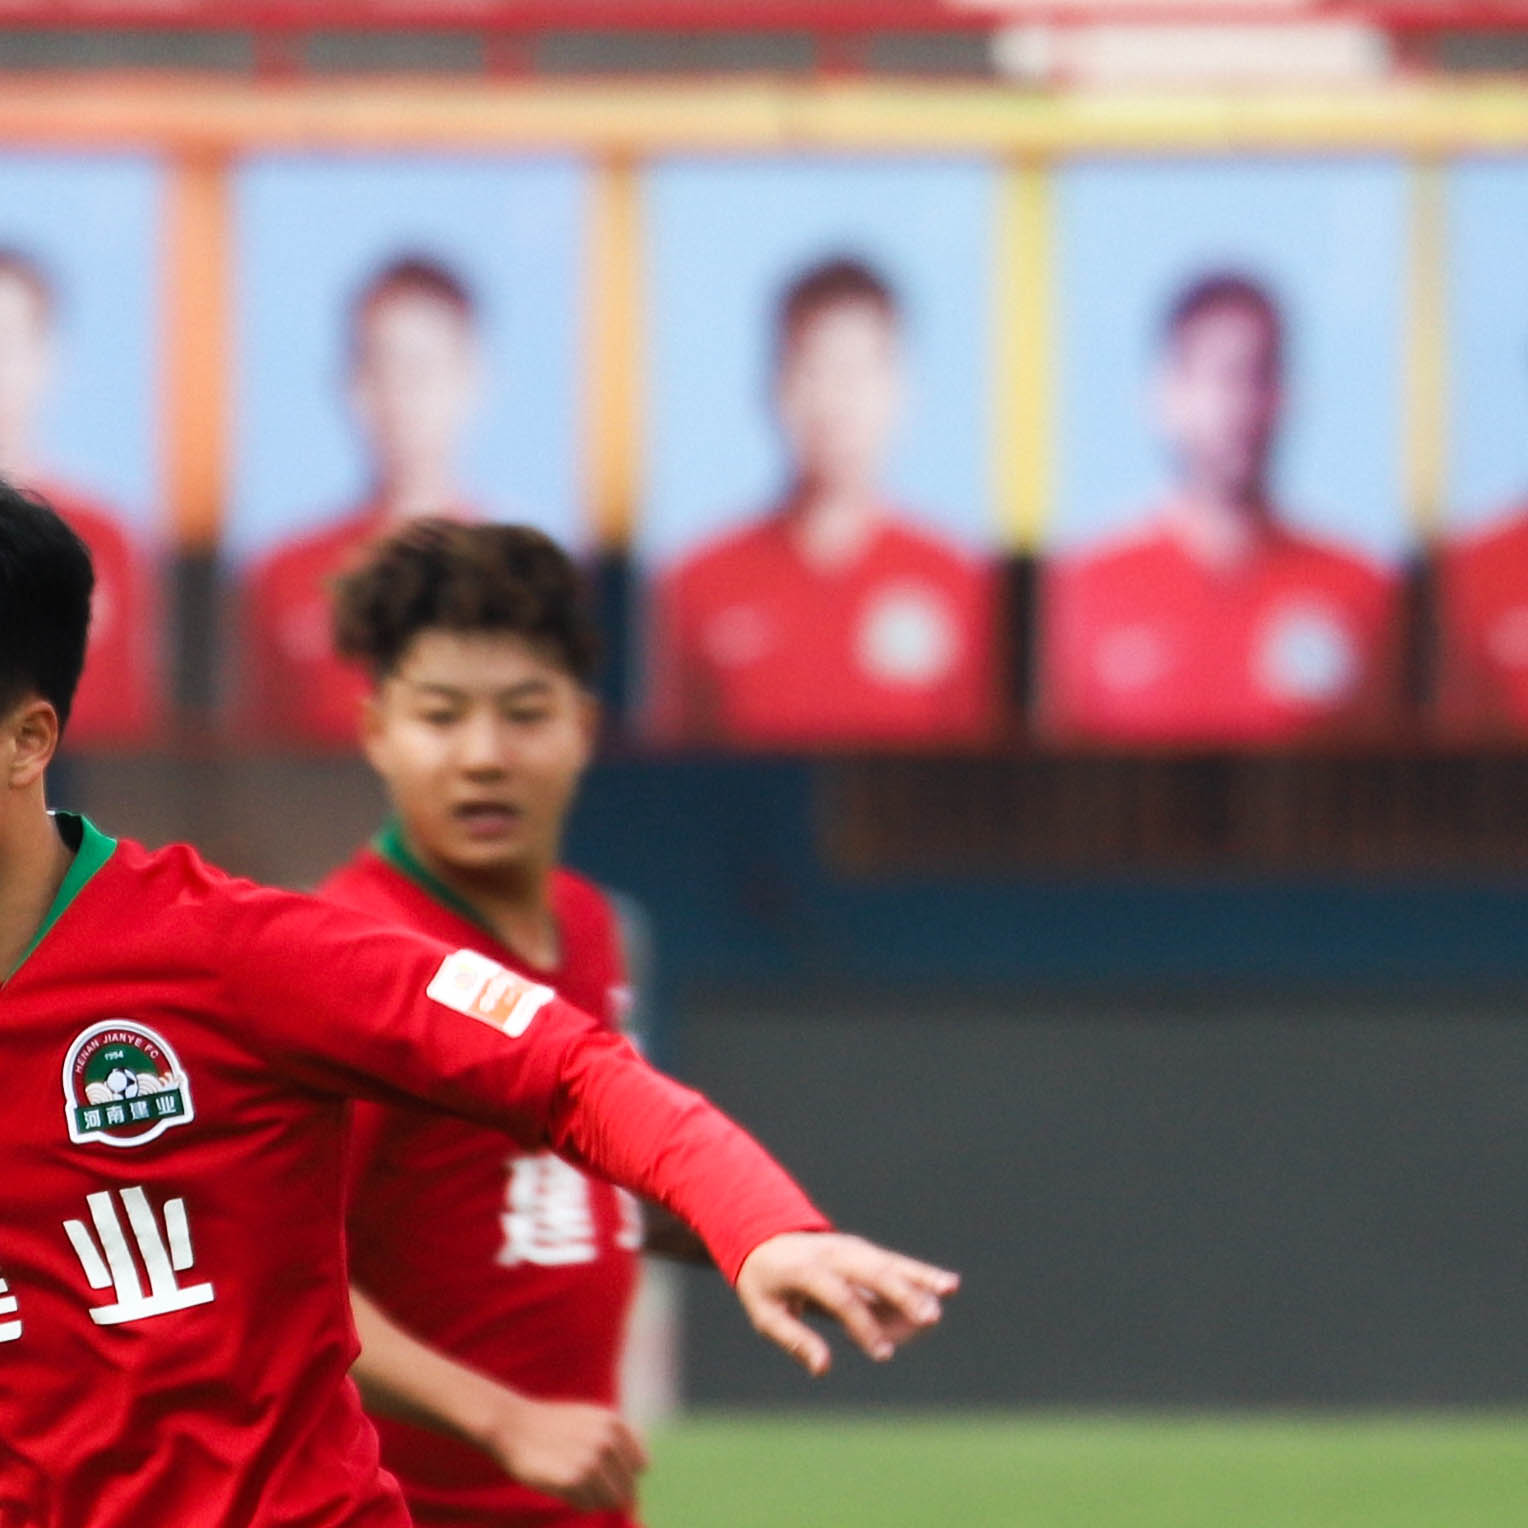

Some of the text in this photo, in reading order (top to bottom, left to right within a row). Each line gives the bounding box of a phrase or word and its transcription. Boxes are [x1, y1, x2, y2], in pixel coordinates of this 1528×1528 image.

[75, 1033, 159, 1073] HENAN JIANYE FC
[84, 1096, 176, 1129] 河南建业
